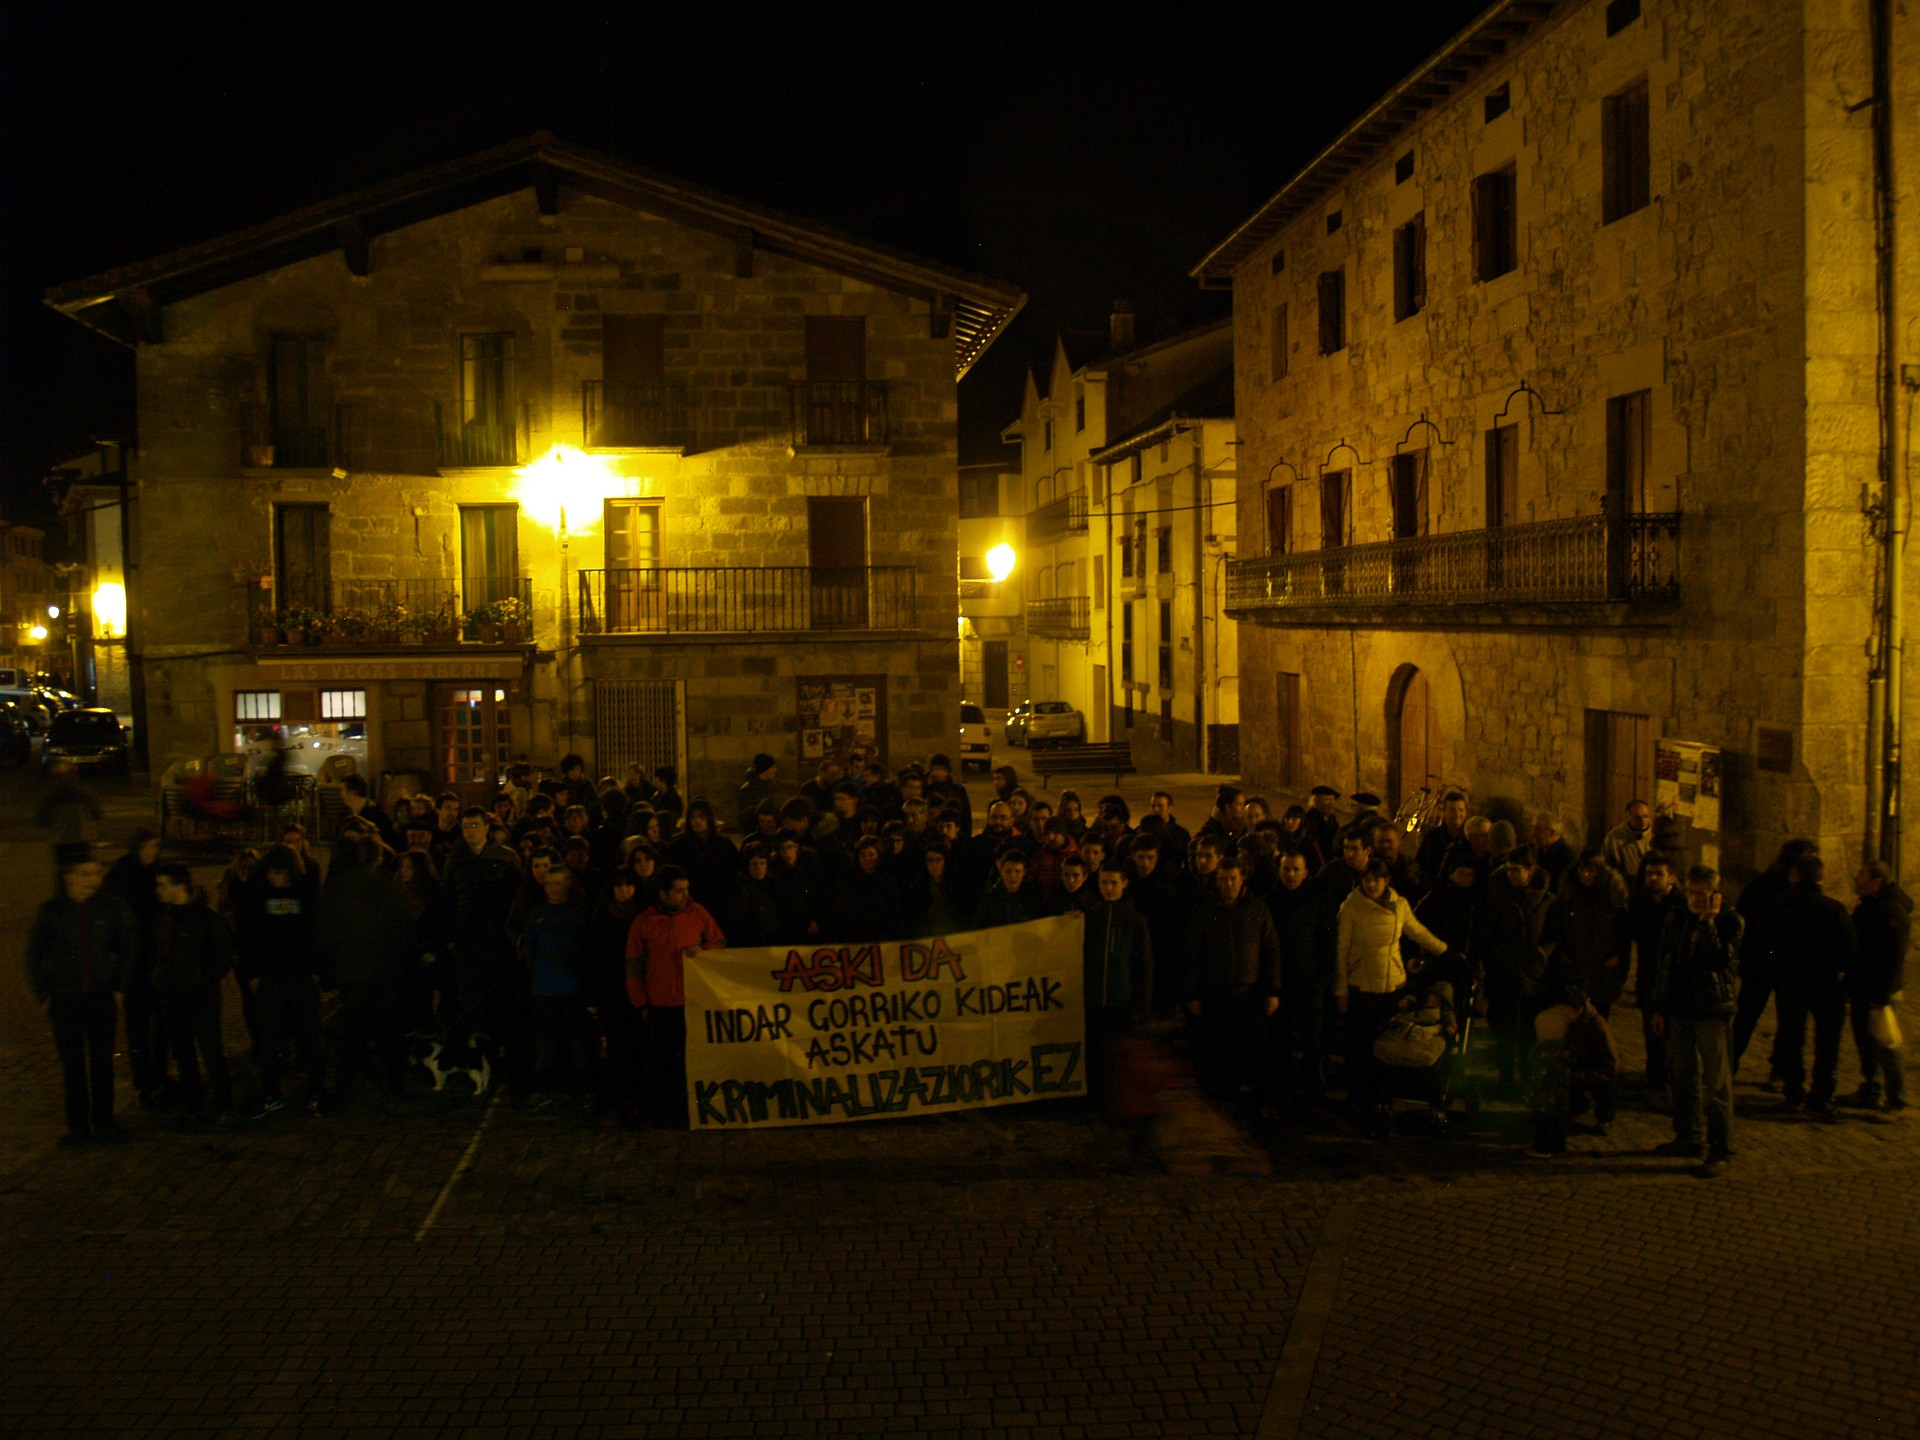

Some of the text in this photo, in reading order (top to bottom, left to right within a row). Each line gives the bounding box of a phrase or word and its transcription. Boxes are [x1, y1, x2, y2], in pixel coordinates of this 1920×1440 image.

[281, 665, 319, 680] LAS
[331, 664, 400, 680] VEGAS
[771, 938, 967, 992] ASKI DA
[705, 977, 1064, 1044] INDAR GORRIKO KIDEAK
[805, 1025, 938, 1069] ASKATU
[695, 1041, 1082, 1125] KRIMINALIZAZIORIK EZ
